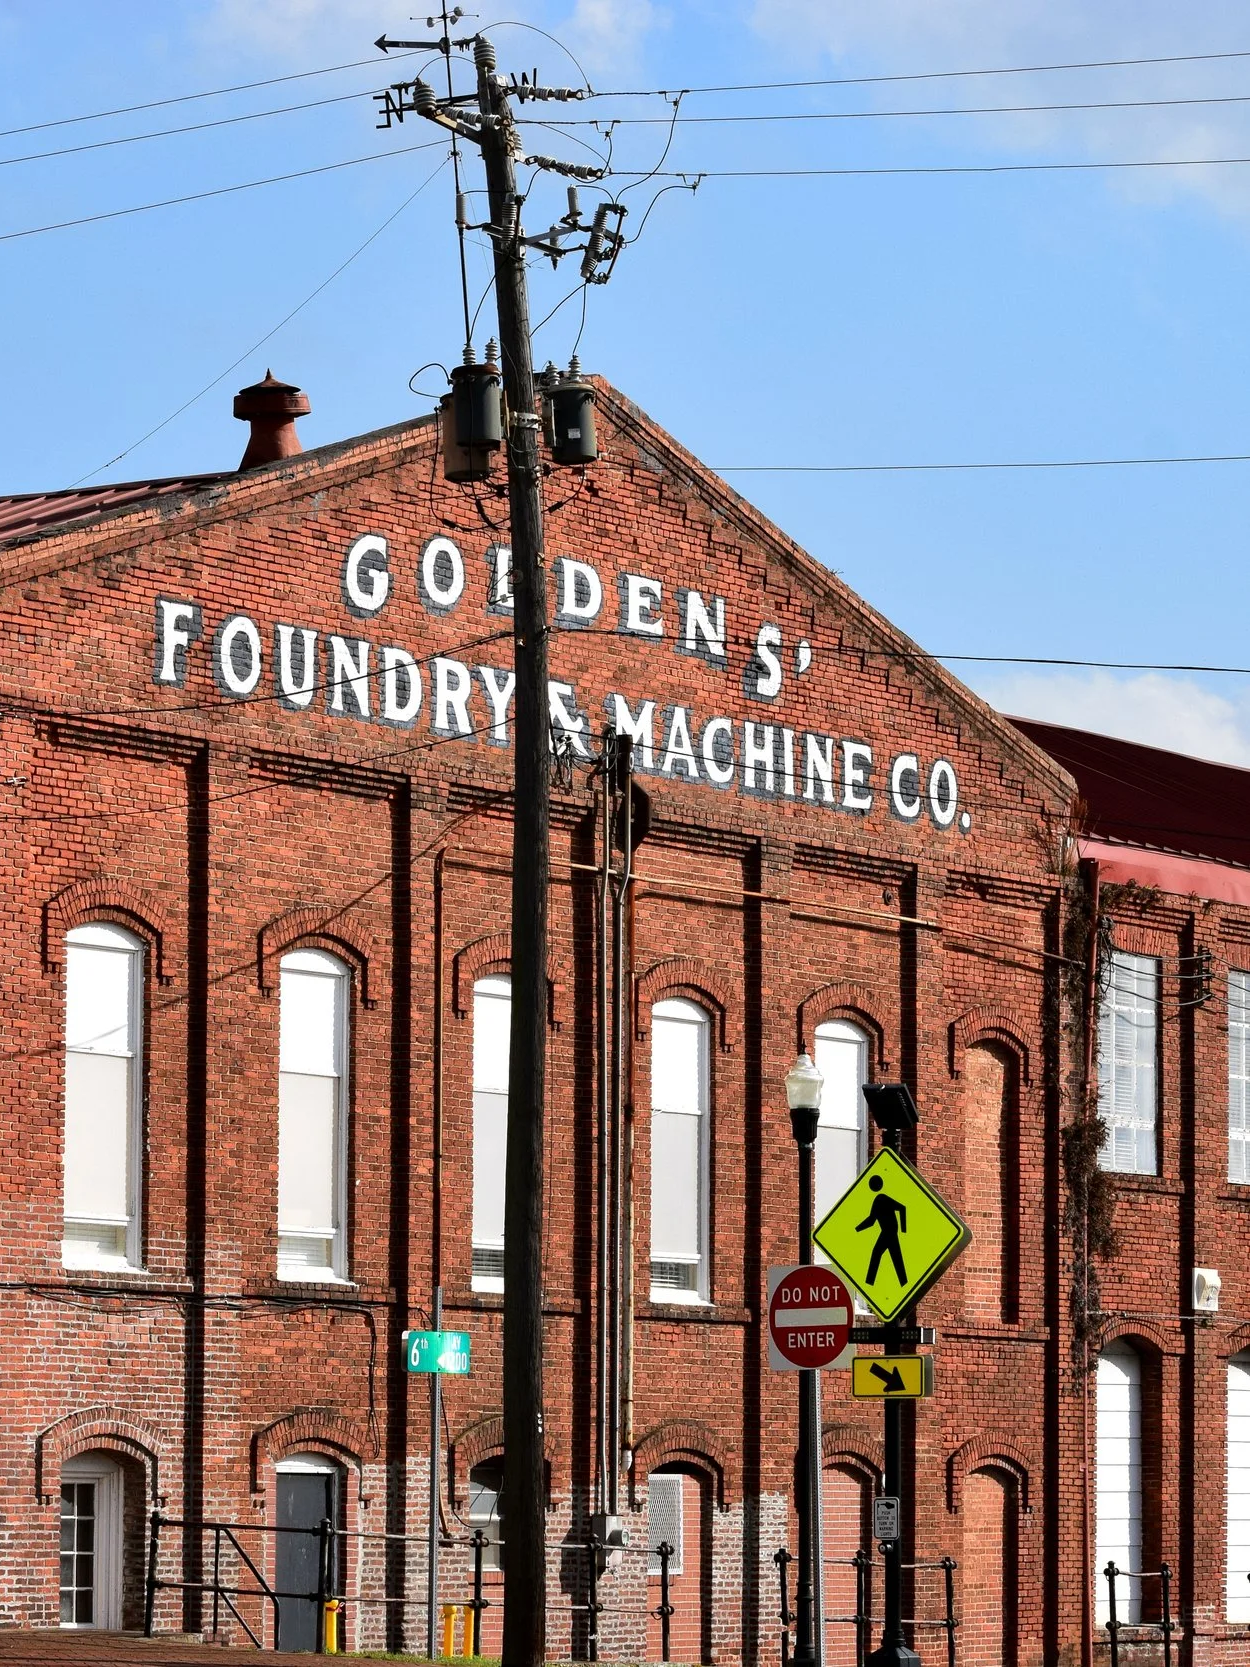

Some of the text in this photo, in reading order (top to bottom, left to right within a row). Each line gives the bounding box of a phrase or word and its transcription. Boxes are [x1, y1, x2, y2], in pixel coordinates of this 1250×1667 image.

[346, 533, 812, 698] GOLDENS'
[153, 600, 516, 741] FOUNDRY
[614, 693, 872, 810] MACHINE
[891, 753, 971, 829] CO.
[781, 1286, 841, 1304] DO NOT
[411, 1337, 429, 1367] 6th
[788, 1332, 835, 1349] ENTER
